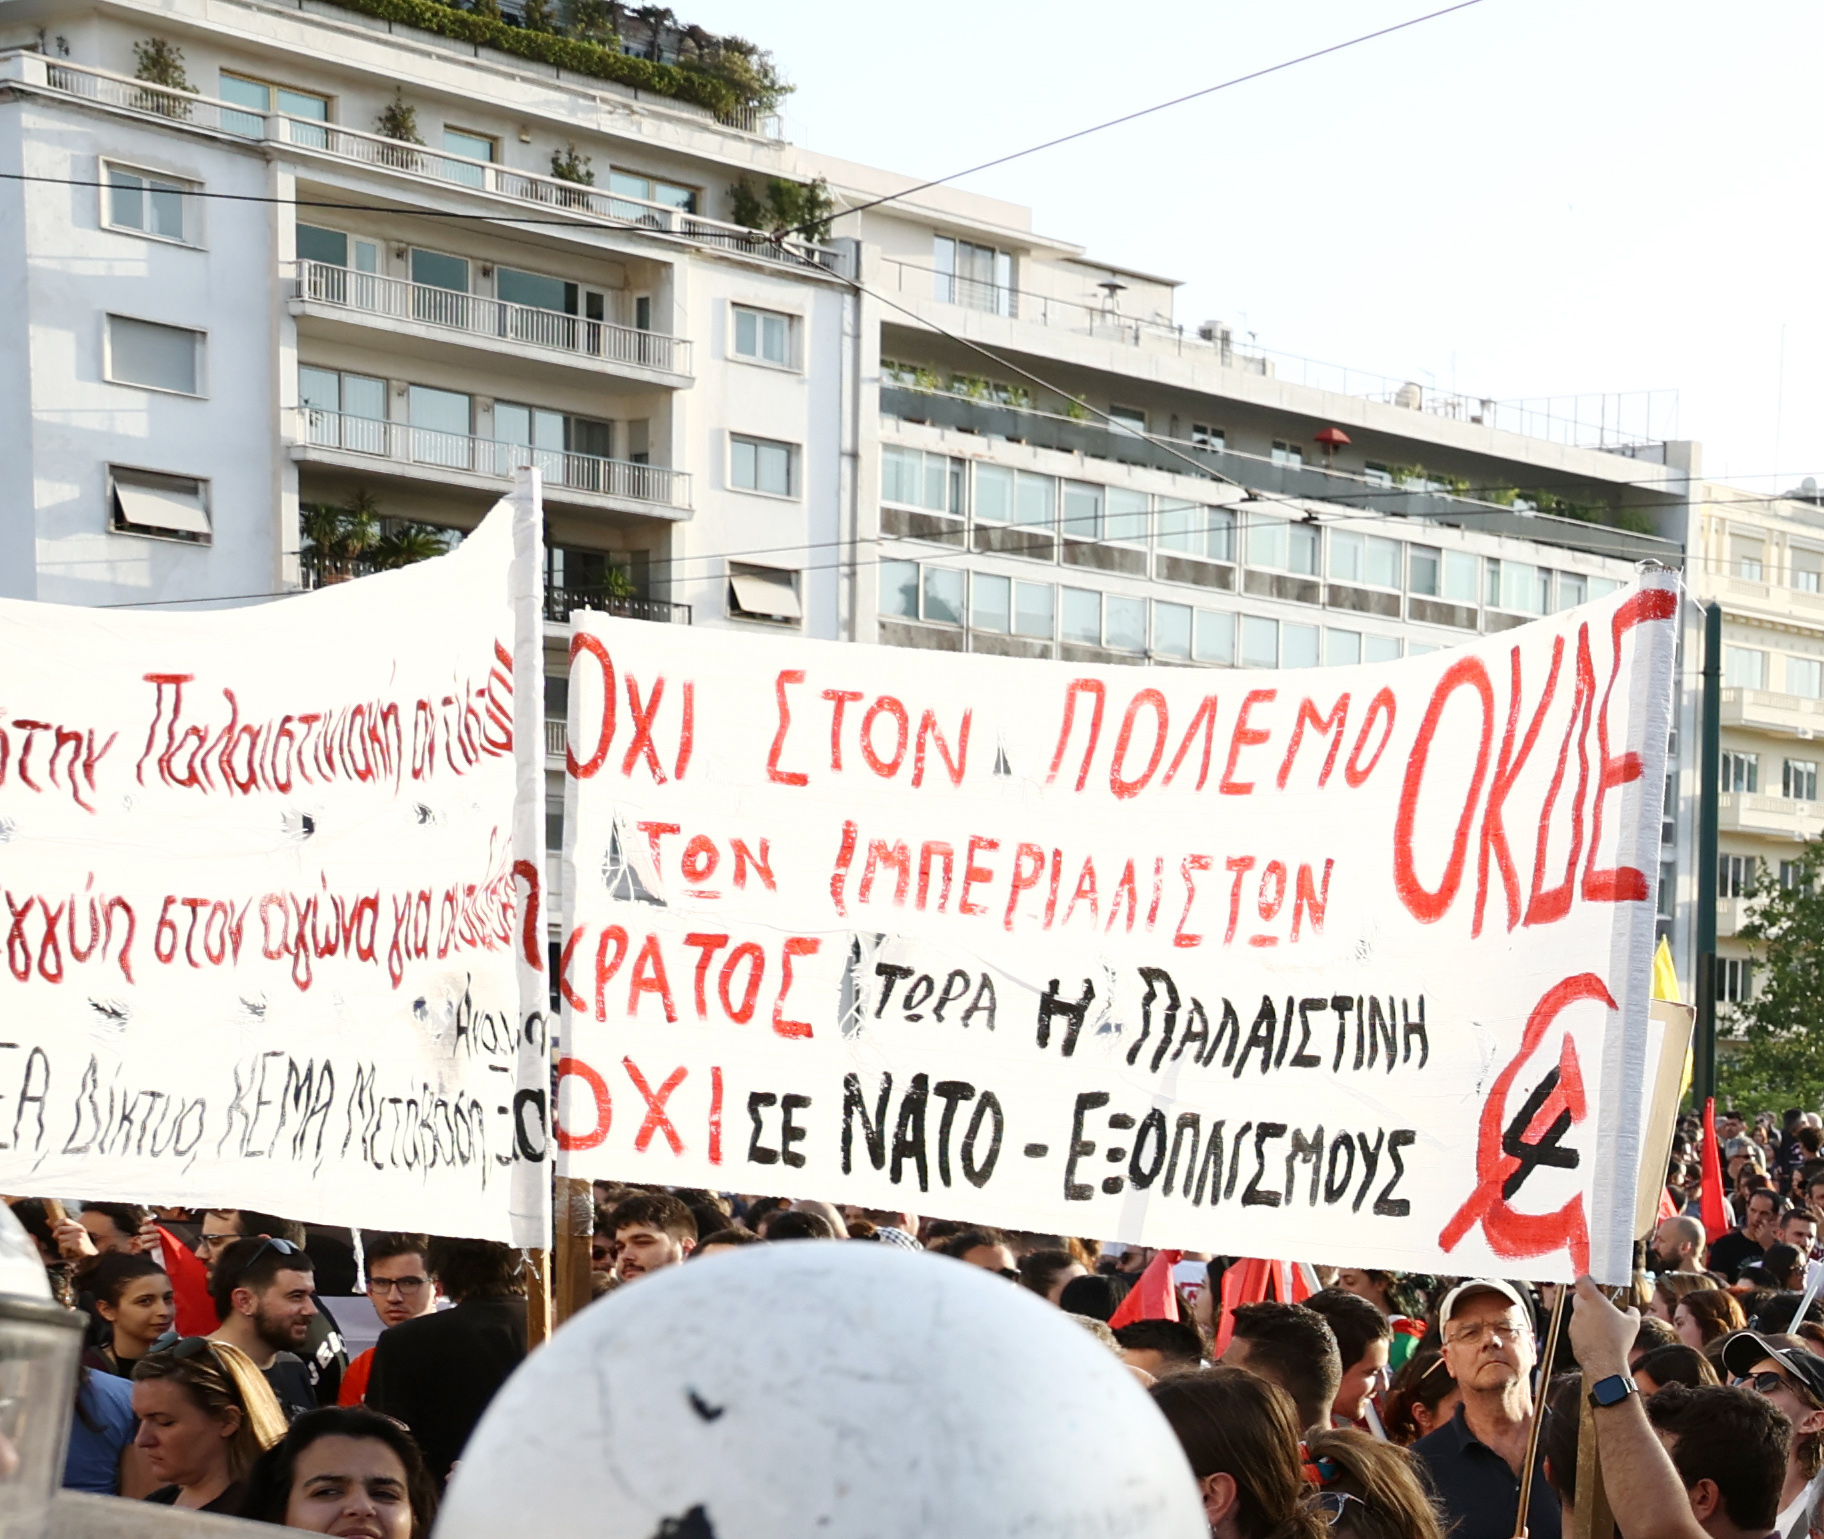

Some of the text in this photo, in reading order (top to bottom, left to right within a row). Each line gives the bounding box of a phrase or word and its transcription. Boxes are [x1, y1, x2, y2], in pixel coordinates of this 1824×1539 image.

[566, 633, 1397, 801] ΟΧΙ ΣΤΟΝ ΠΟΛΕΜΟ
[1393, 588, 1678, 940] ΟΚΔΕ
[154, 892, 250, 969] στον
[636, 820, 1336, 948] ΤΩΝ ΙΜΠΕΡΙΑΛΙΣΤΩΝ
[559, 925, 822, 1039] ΚΡΑΤΟΣ
[874, 961, 998, 1032] ΤΩΡΑ
[1036, 976, 1096, 1058] Η
[1126, 966, 1430, 1078] ΠΑΛΑΙΣΤΙΝΗ
[556, 1055, 724, 1166] ΟΧΙ
[747, 1091, 812, 1168] ΣΕ
[840, 1072, 1004, 1192] ΝΑΤΟ
[1063, 1091, 1417, 1217] ΕΞΟΠΛΙΣΜΟΥΣ
